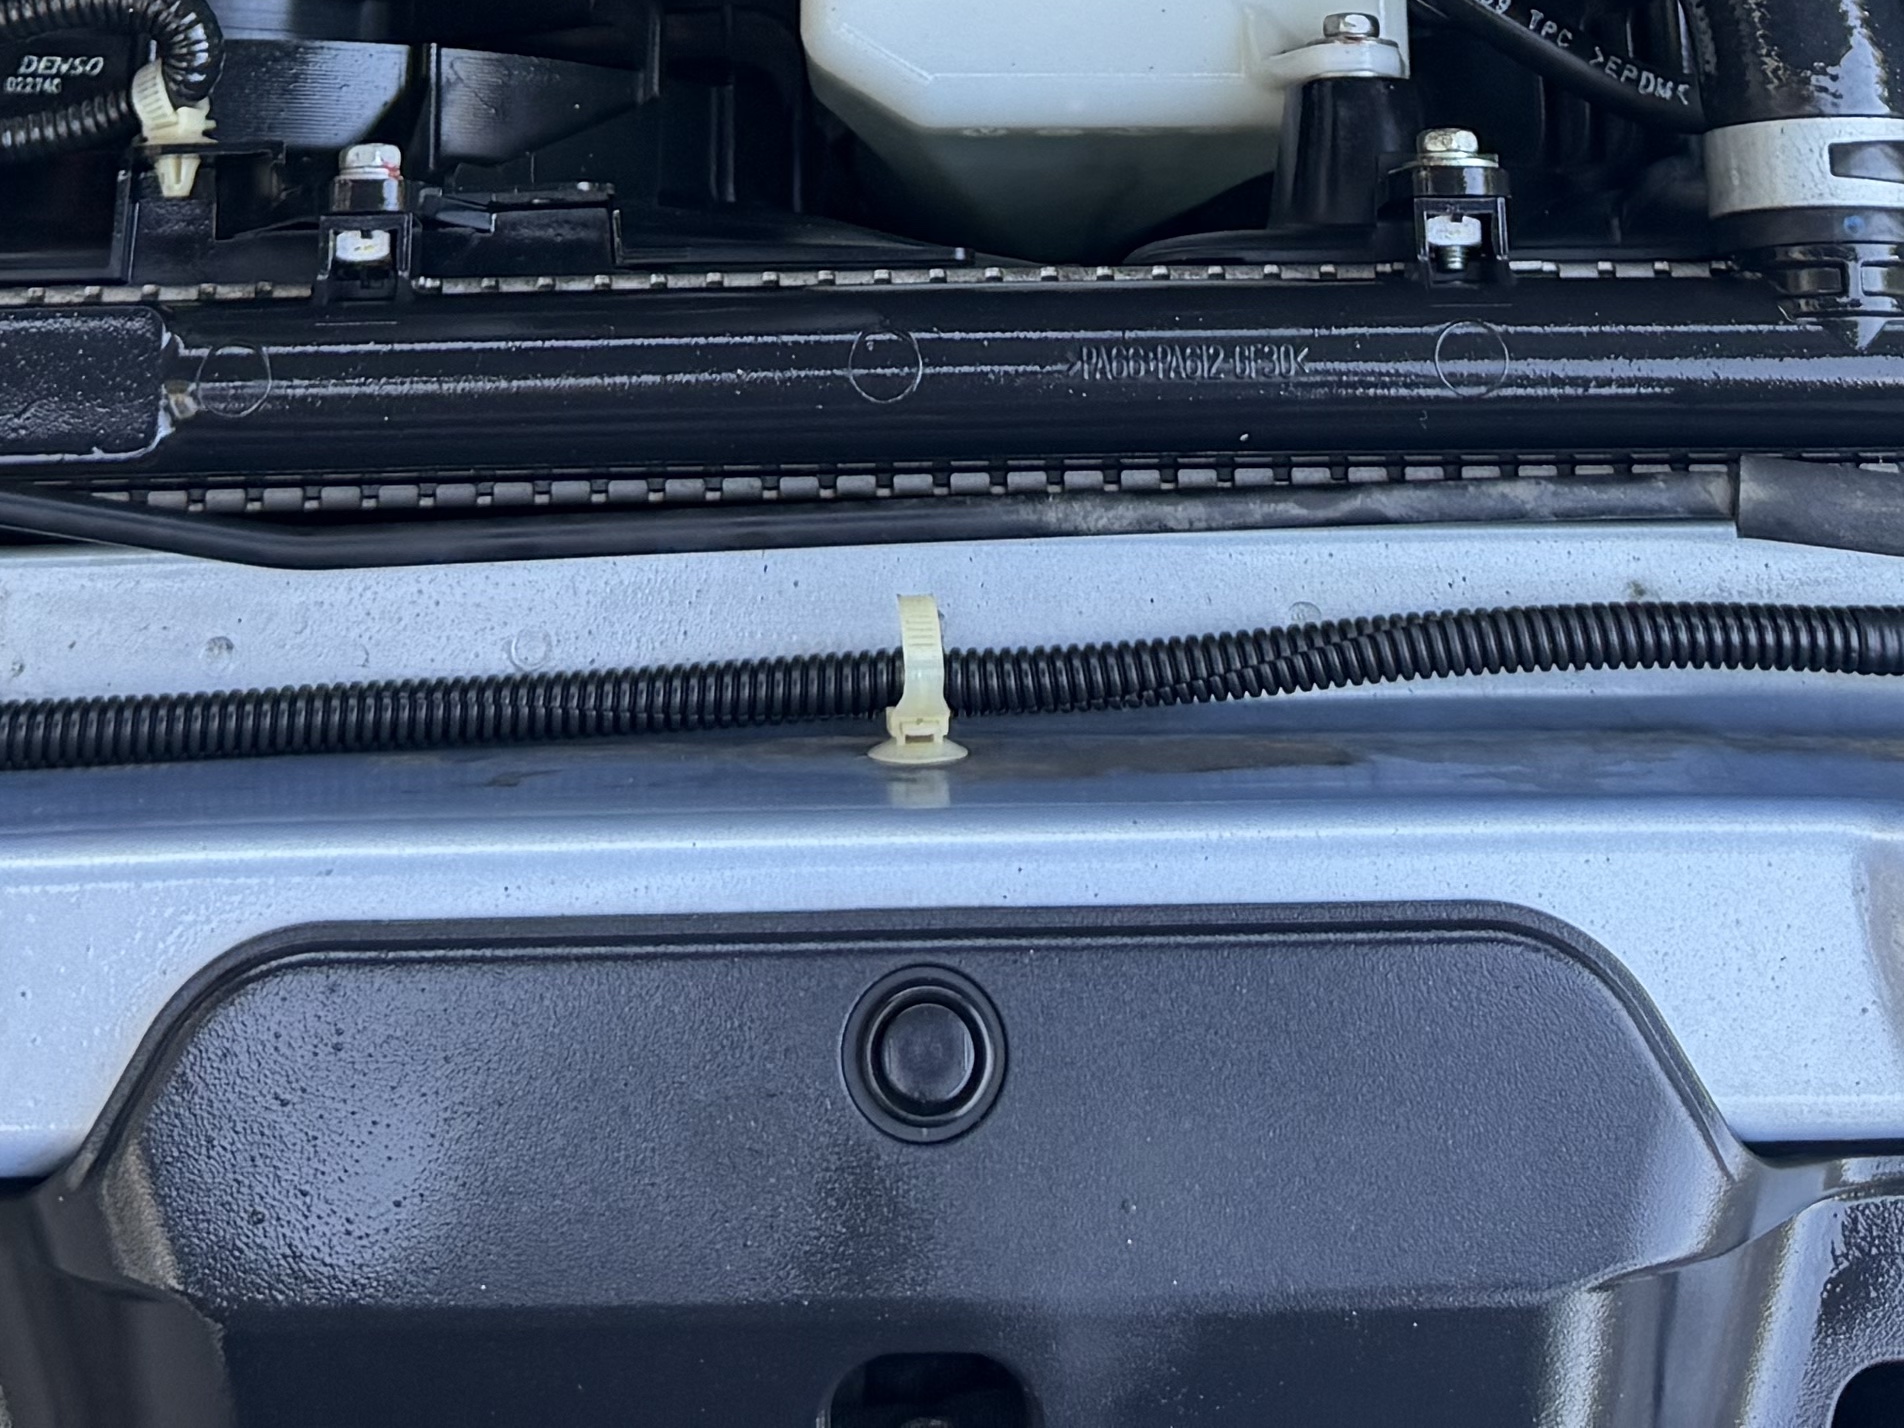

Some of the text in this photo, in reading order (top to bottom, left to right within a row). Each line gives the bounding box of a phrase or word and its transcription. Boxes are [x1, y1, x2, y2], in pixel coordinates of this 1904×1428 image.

[17, 55, 105, 76] DENSO
[1527, 8, 1575, 49] TPC
[1588, 46, 1692, 106] >EPDM<
